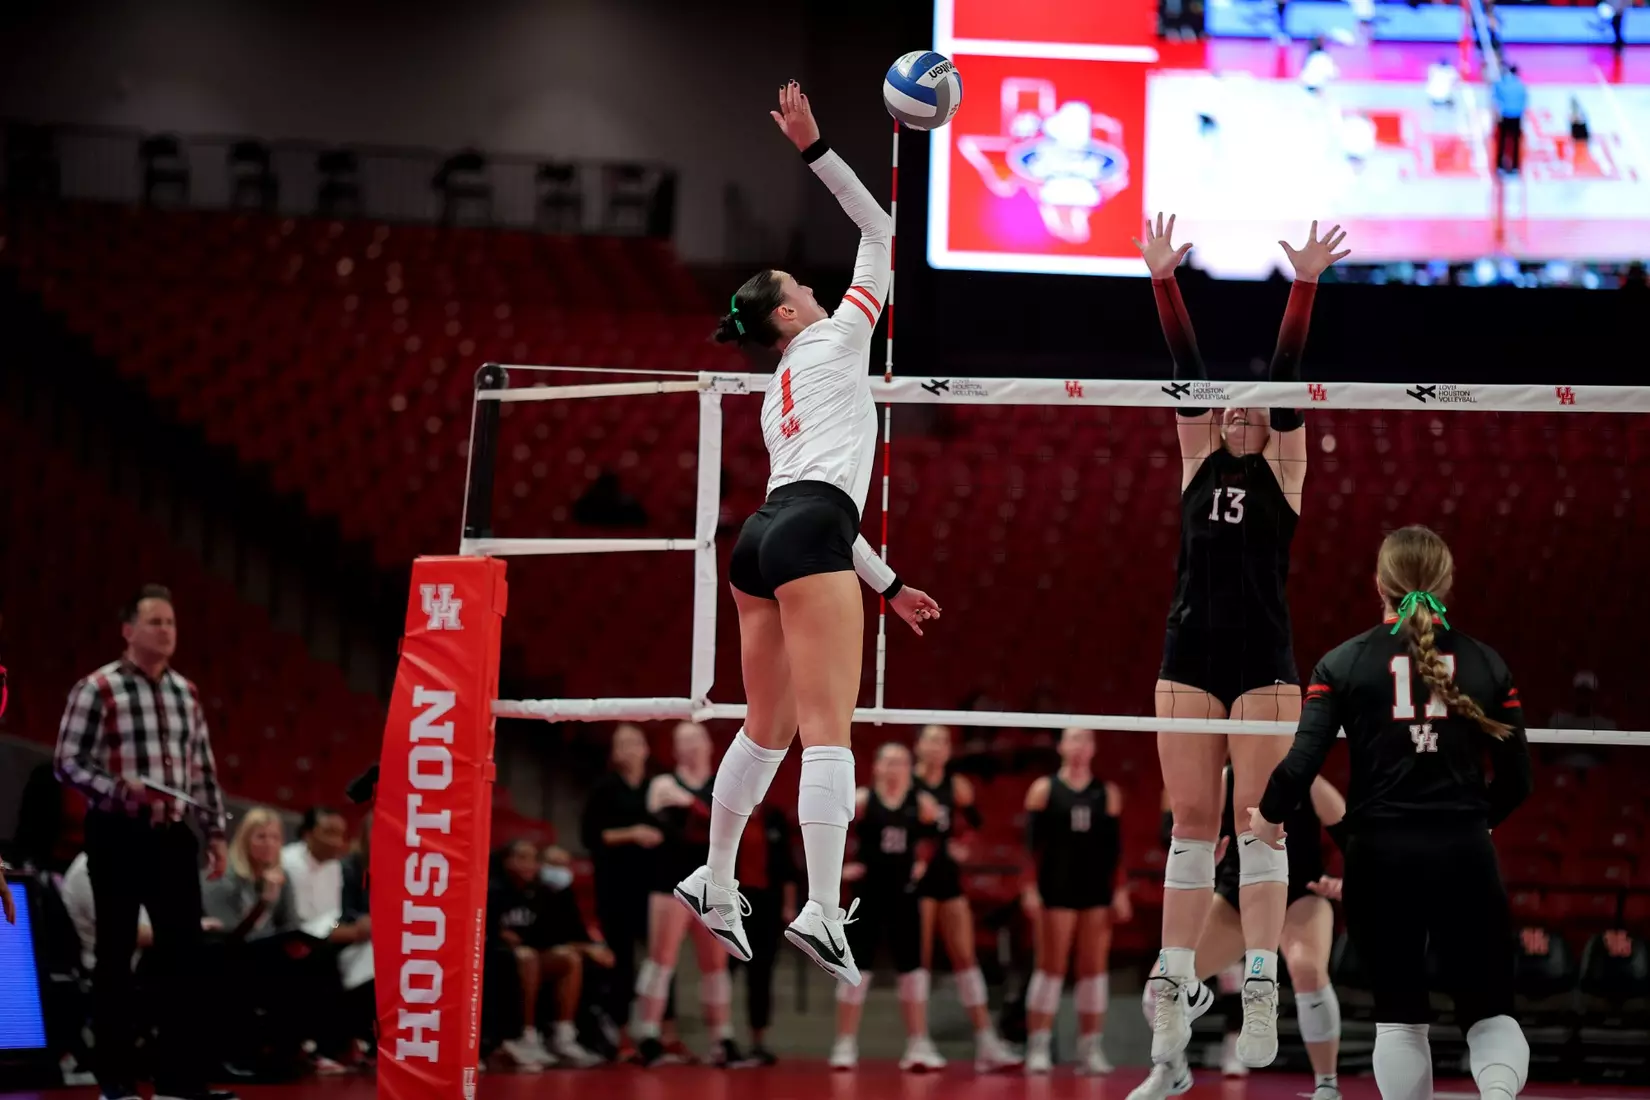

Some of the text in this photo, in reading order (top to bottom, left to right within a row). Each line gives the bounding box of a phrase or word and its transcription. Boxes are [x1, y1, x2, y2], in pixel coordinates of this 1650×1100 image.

[928, 61, 955, 79] olten
[781, 367, 794, 418] 1
[1208, 487, 1246, 524] 13
[395, 685, 456, 1063] HOUSTON
